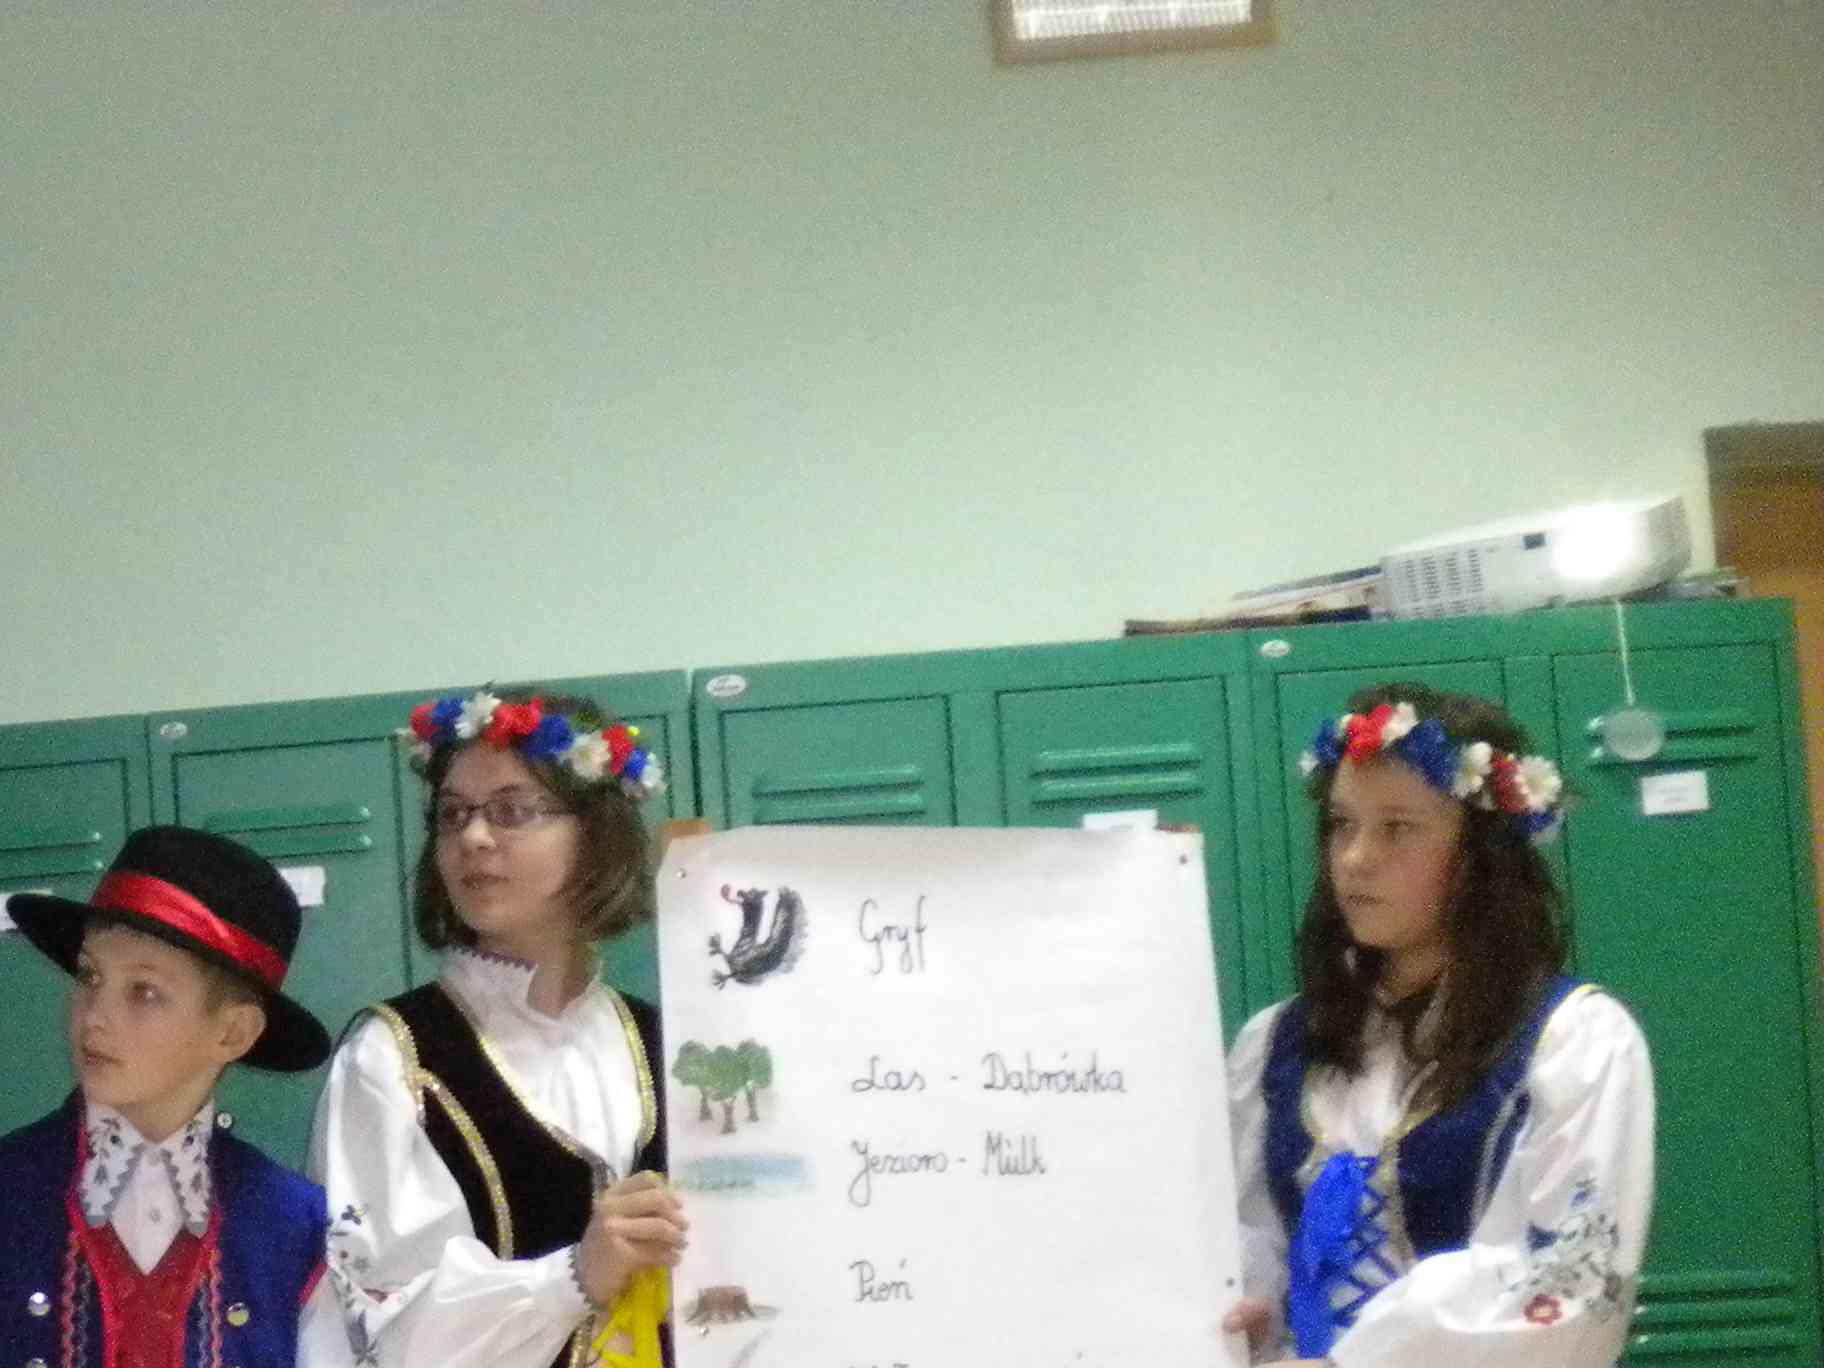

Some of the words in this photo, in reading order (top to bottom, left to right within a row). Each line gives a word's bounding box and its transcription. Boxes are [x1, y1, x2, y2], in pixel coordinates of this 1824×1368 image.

[859, 894, 927, 975] Gryf
[851, 1054, 925, 1092] Las
[849, 1257, 914, 1302] Pień
